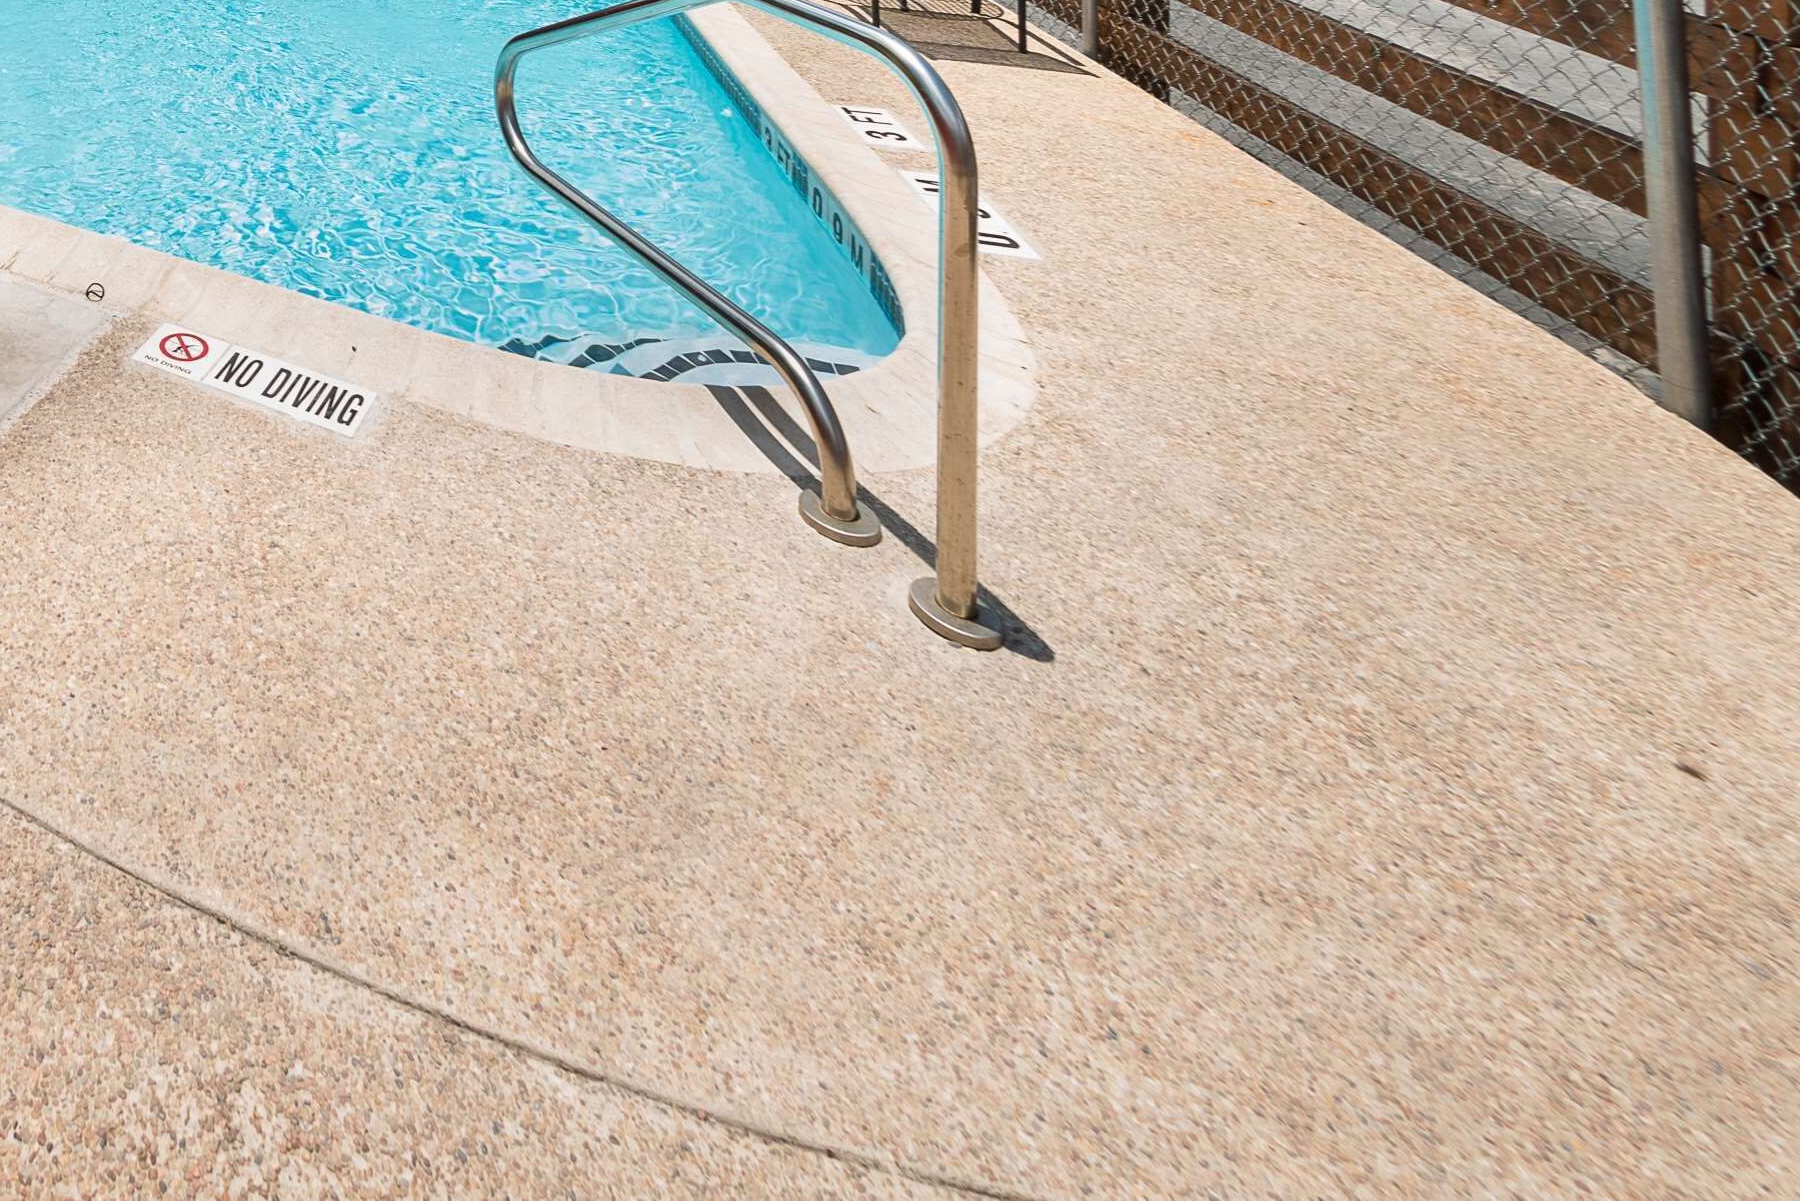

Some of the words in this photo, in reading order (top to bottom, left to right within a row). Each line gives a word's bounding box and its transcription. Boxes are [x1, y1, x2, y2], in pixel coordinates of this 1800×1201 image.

[840, 106, 894, 126] FT
[865, 130, 907, 141] 3
[143, 354, 160, 363] NO
[160, 360, 193, 375] DIVING
[214, 351, 264, 388] NO
[261, 367, 365, 427] DIVING
